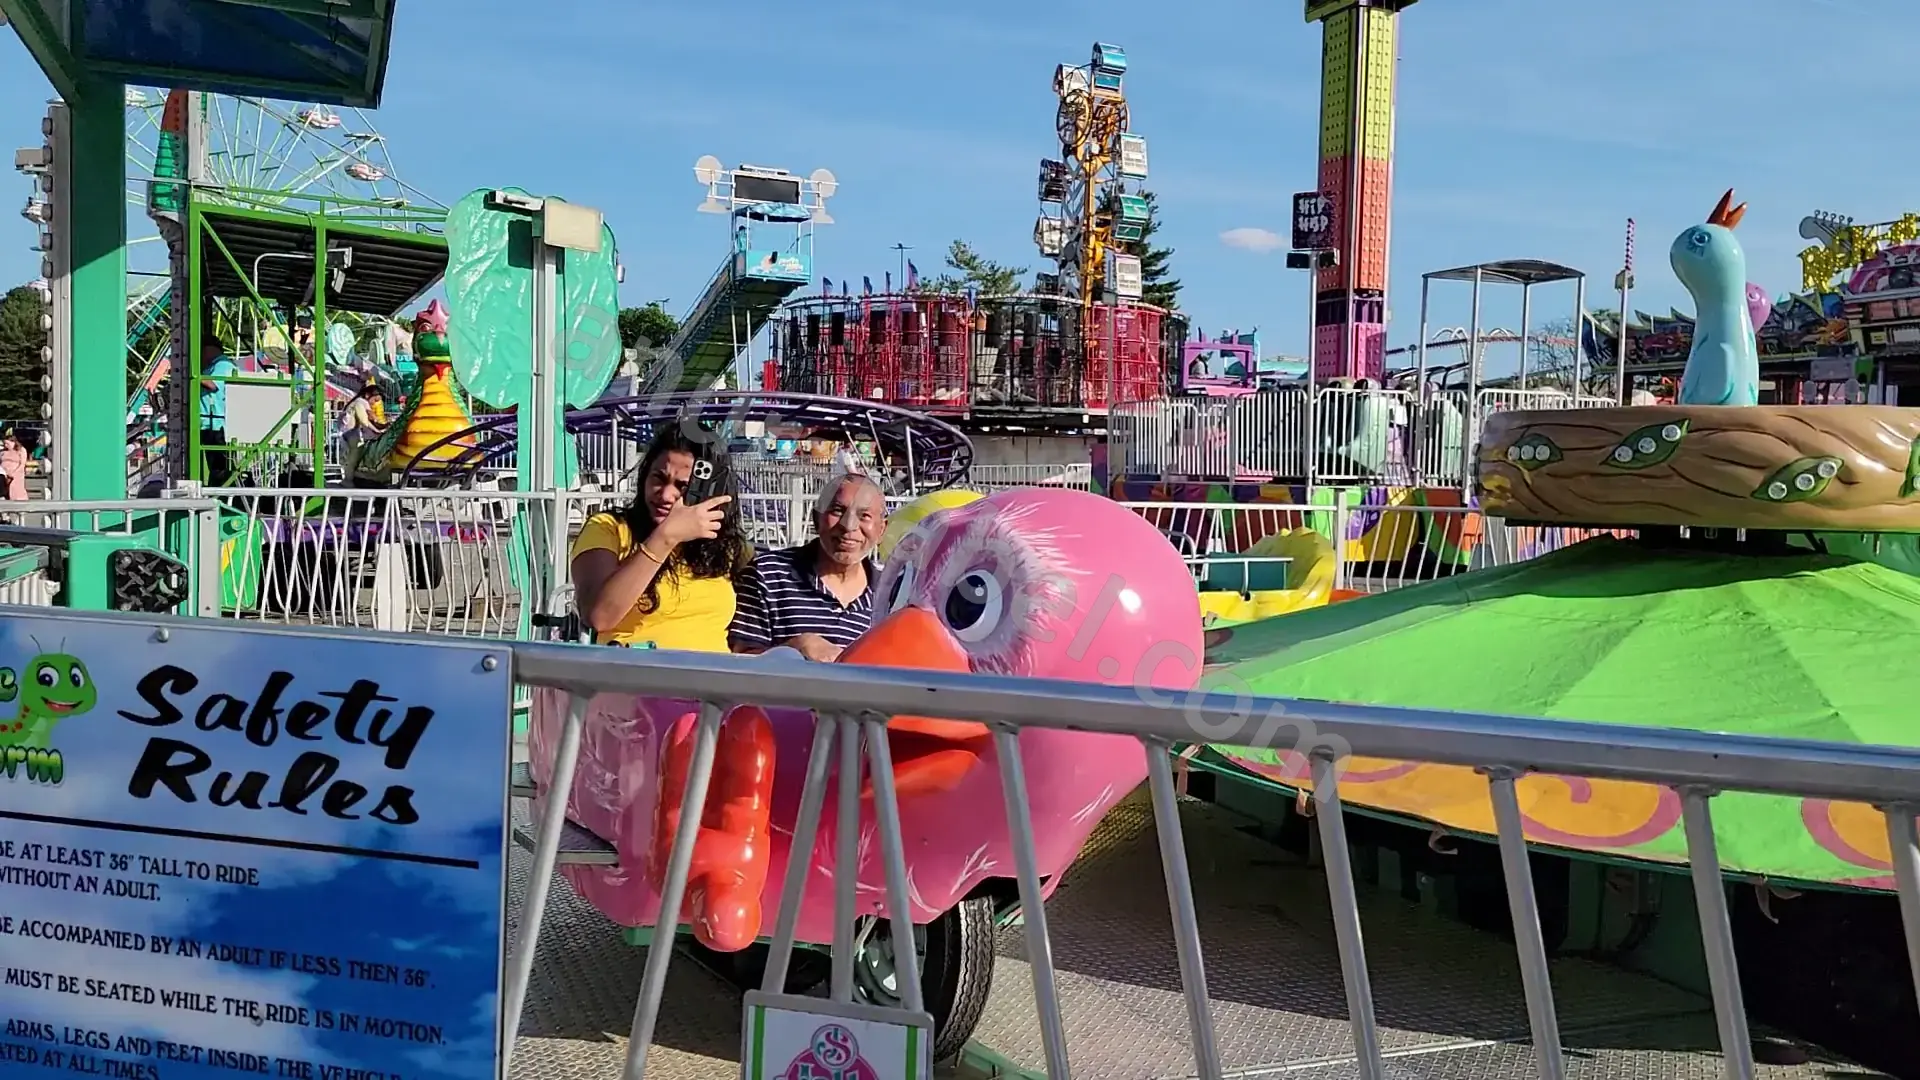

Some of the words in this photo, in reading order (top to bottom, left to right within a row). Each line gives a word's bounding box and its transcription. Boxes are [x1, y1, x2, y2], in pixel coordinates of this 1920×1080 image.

[117, 664, 435, 770] Safety
[0, 745, 63, 784] rm
[128, 737, 419, 825] Rules
[20, 843, 43, 860] AT
[47, 845, 105, 869] LEAST
[109, 853, 134, 872] 36"
[139, 855, 182, 878] TALL
[185, 860, 210, 881] TO
[215, 864, 259, 886] RIDE
[74, 874, 99, 894] AN
[103, 878, 161, 901] ADULT.
[0, 916, 14, 934] E
[19, 919, 146, 951] ACCOMPANIED
[151, 935, 173, 955] BY
[176, 938, 201, 959] AN
[206, 943, 263, 967] ADULT
[269, 950, 286, 969] IF
[292, 952, 341, 976] LESS
[347, 959, 399, 984] THEN
[5, 967, 53, 990] MUST
[58, 975, 81, 994] BE
[85, 978, 155, 1005] SEATED
[160, 988, 218, 1014] WHILE
[221, 997, 260, 1020] THE
[265, 1002, 310, 1027] RIDE
[315, 1009, 334, 1030] IS
[339, 1012, 359, 1033] IN
[364, 1015, 446, 1046] MOTION.
[5, 1018, 59, 1045] ARMS,
[64, 1026, 110, 1050] LEGS
[115, 1035, 151, 1057] AND
[156, 1040, 204, 1064] FEET
[207, 1047, 270, 1074] INSIDE
[275, 1057, 313, 1080] THE
[42, 1049, 63, 1068] AT
[67, 1053, 100, 1074] ALL
